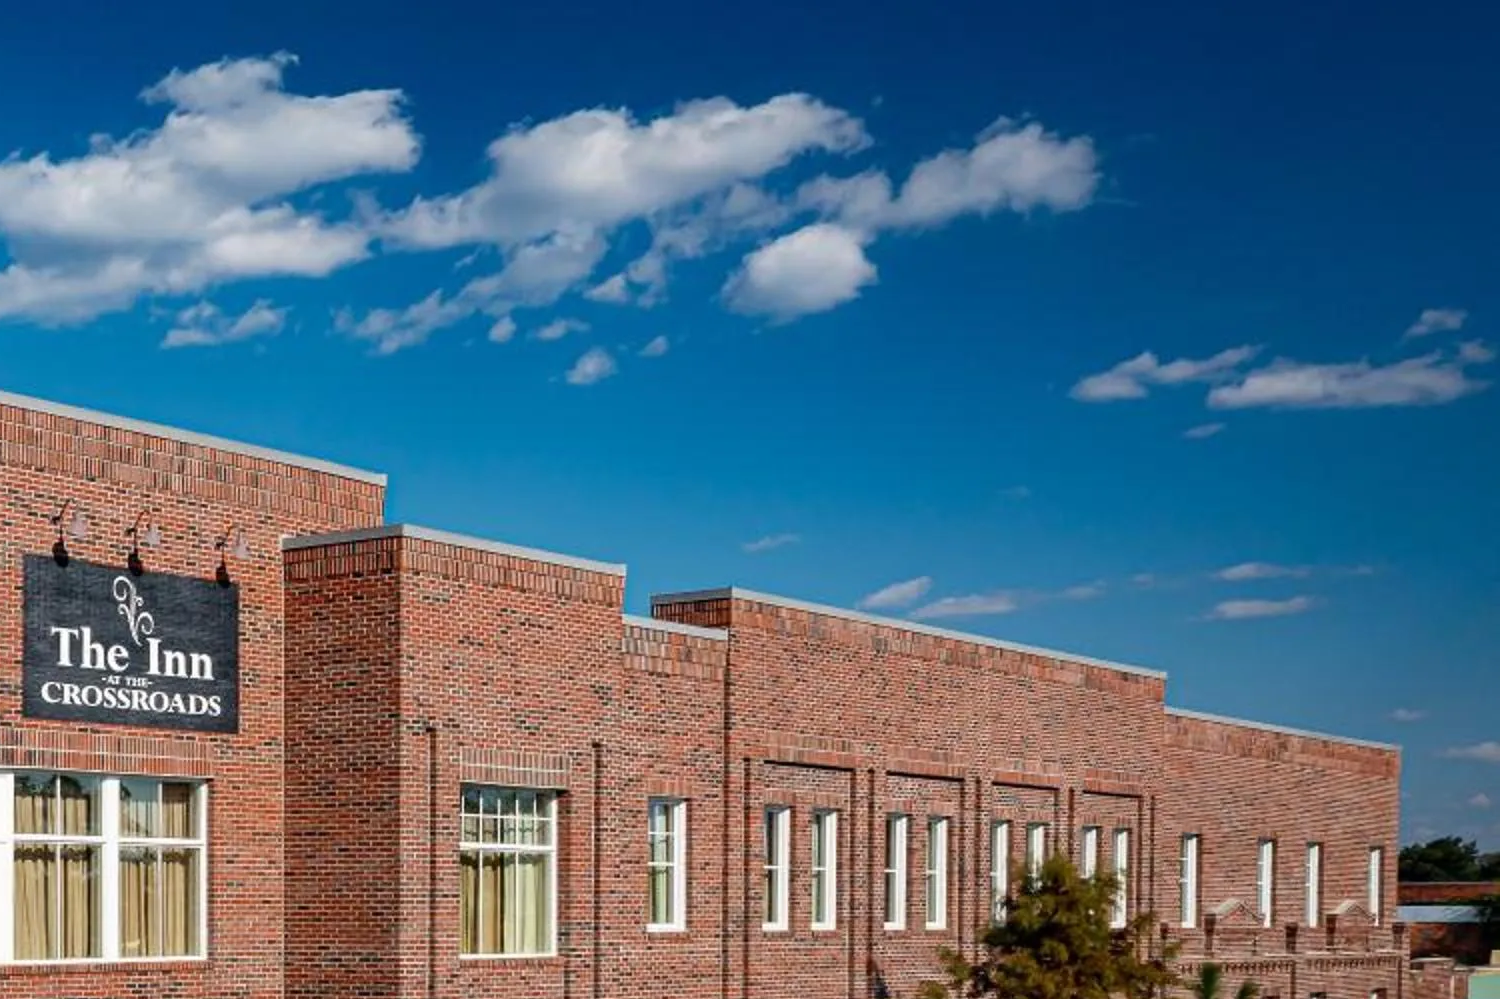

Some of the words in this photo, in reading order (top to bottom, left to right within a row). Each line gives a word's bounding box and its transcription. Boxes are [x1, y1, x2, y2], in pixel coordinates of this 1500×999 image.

[51, 626, 130, 672] The
[146, 637, 215, 680] Inn
[41, 681, 221, 717] CROSSROADS
